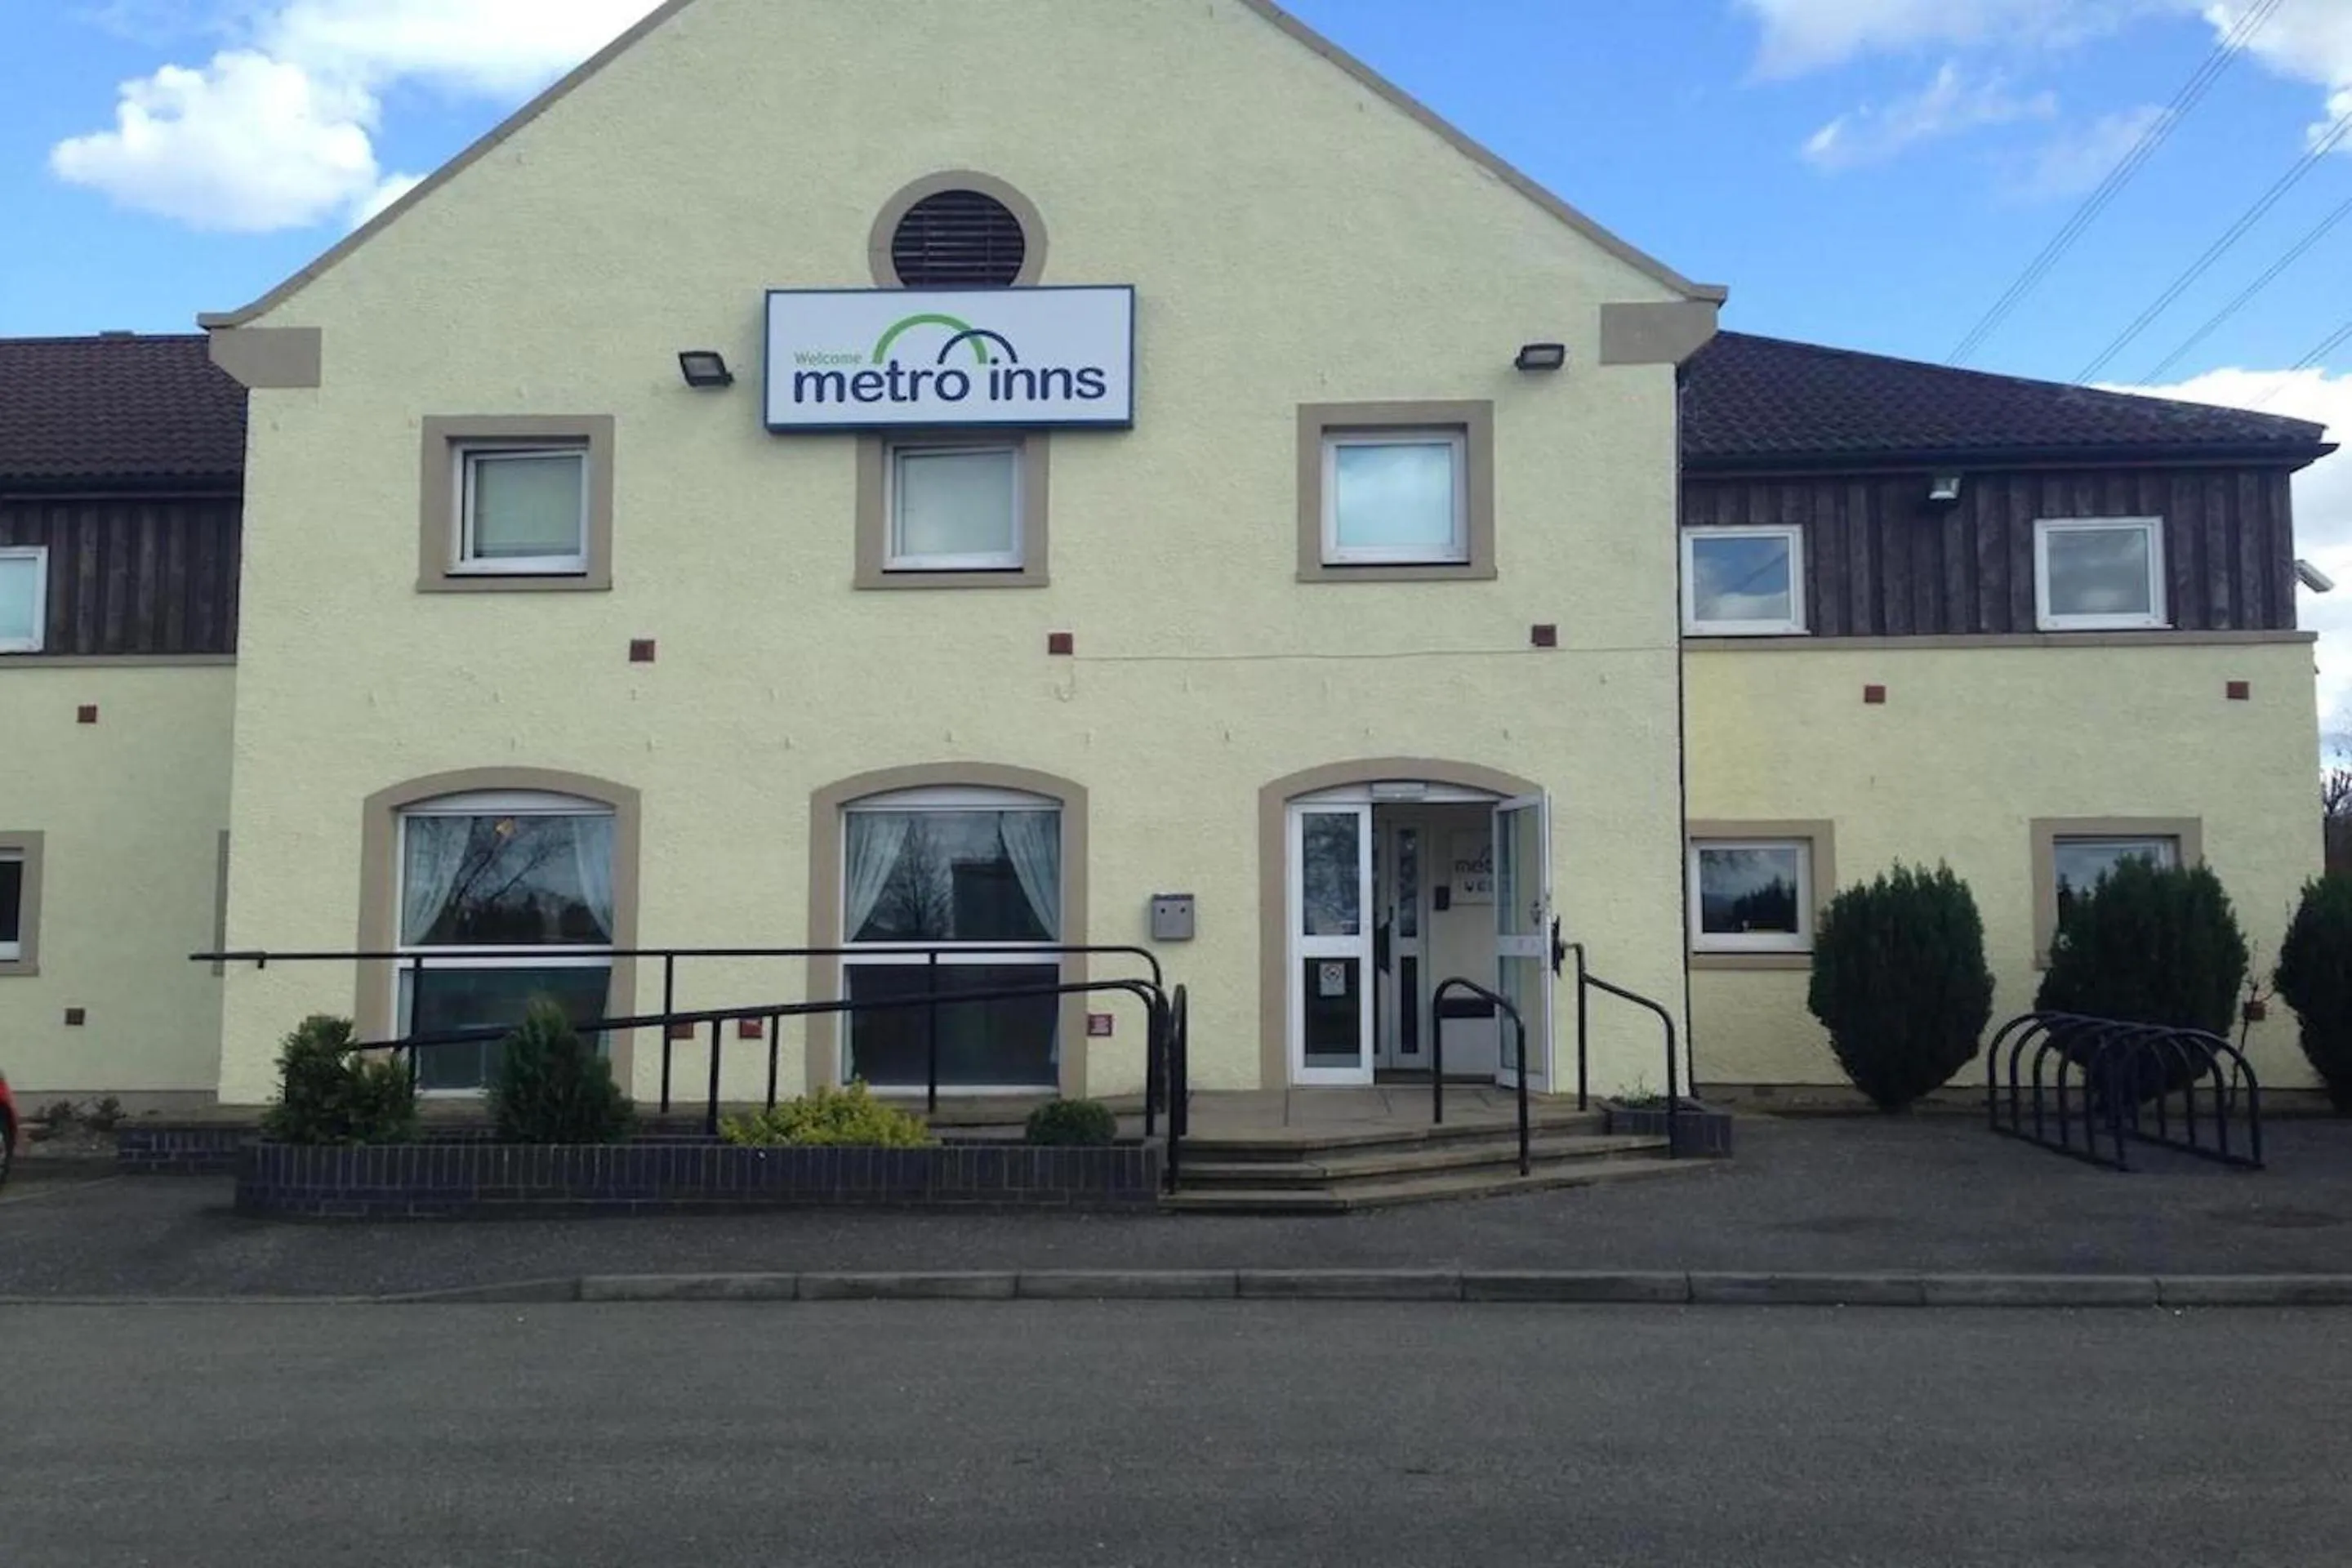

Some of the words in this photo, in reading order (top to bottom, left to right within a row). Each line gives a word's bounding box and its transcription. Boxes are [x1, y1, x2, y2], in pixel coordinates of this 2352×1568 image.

[794, 351, 862, 365] Welcome
[794, 359, 970, 403] metro
[990, 358, 1107, 401] inns
